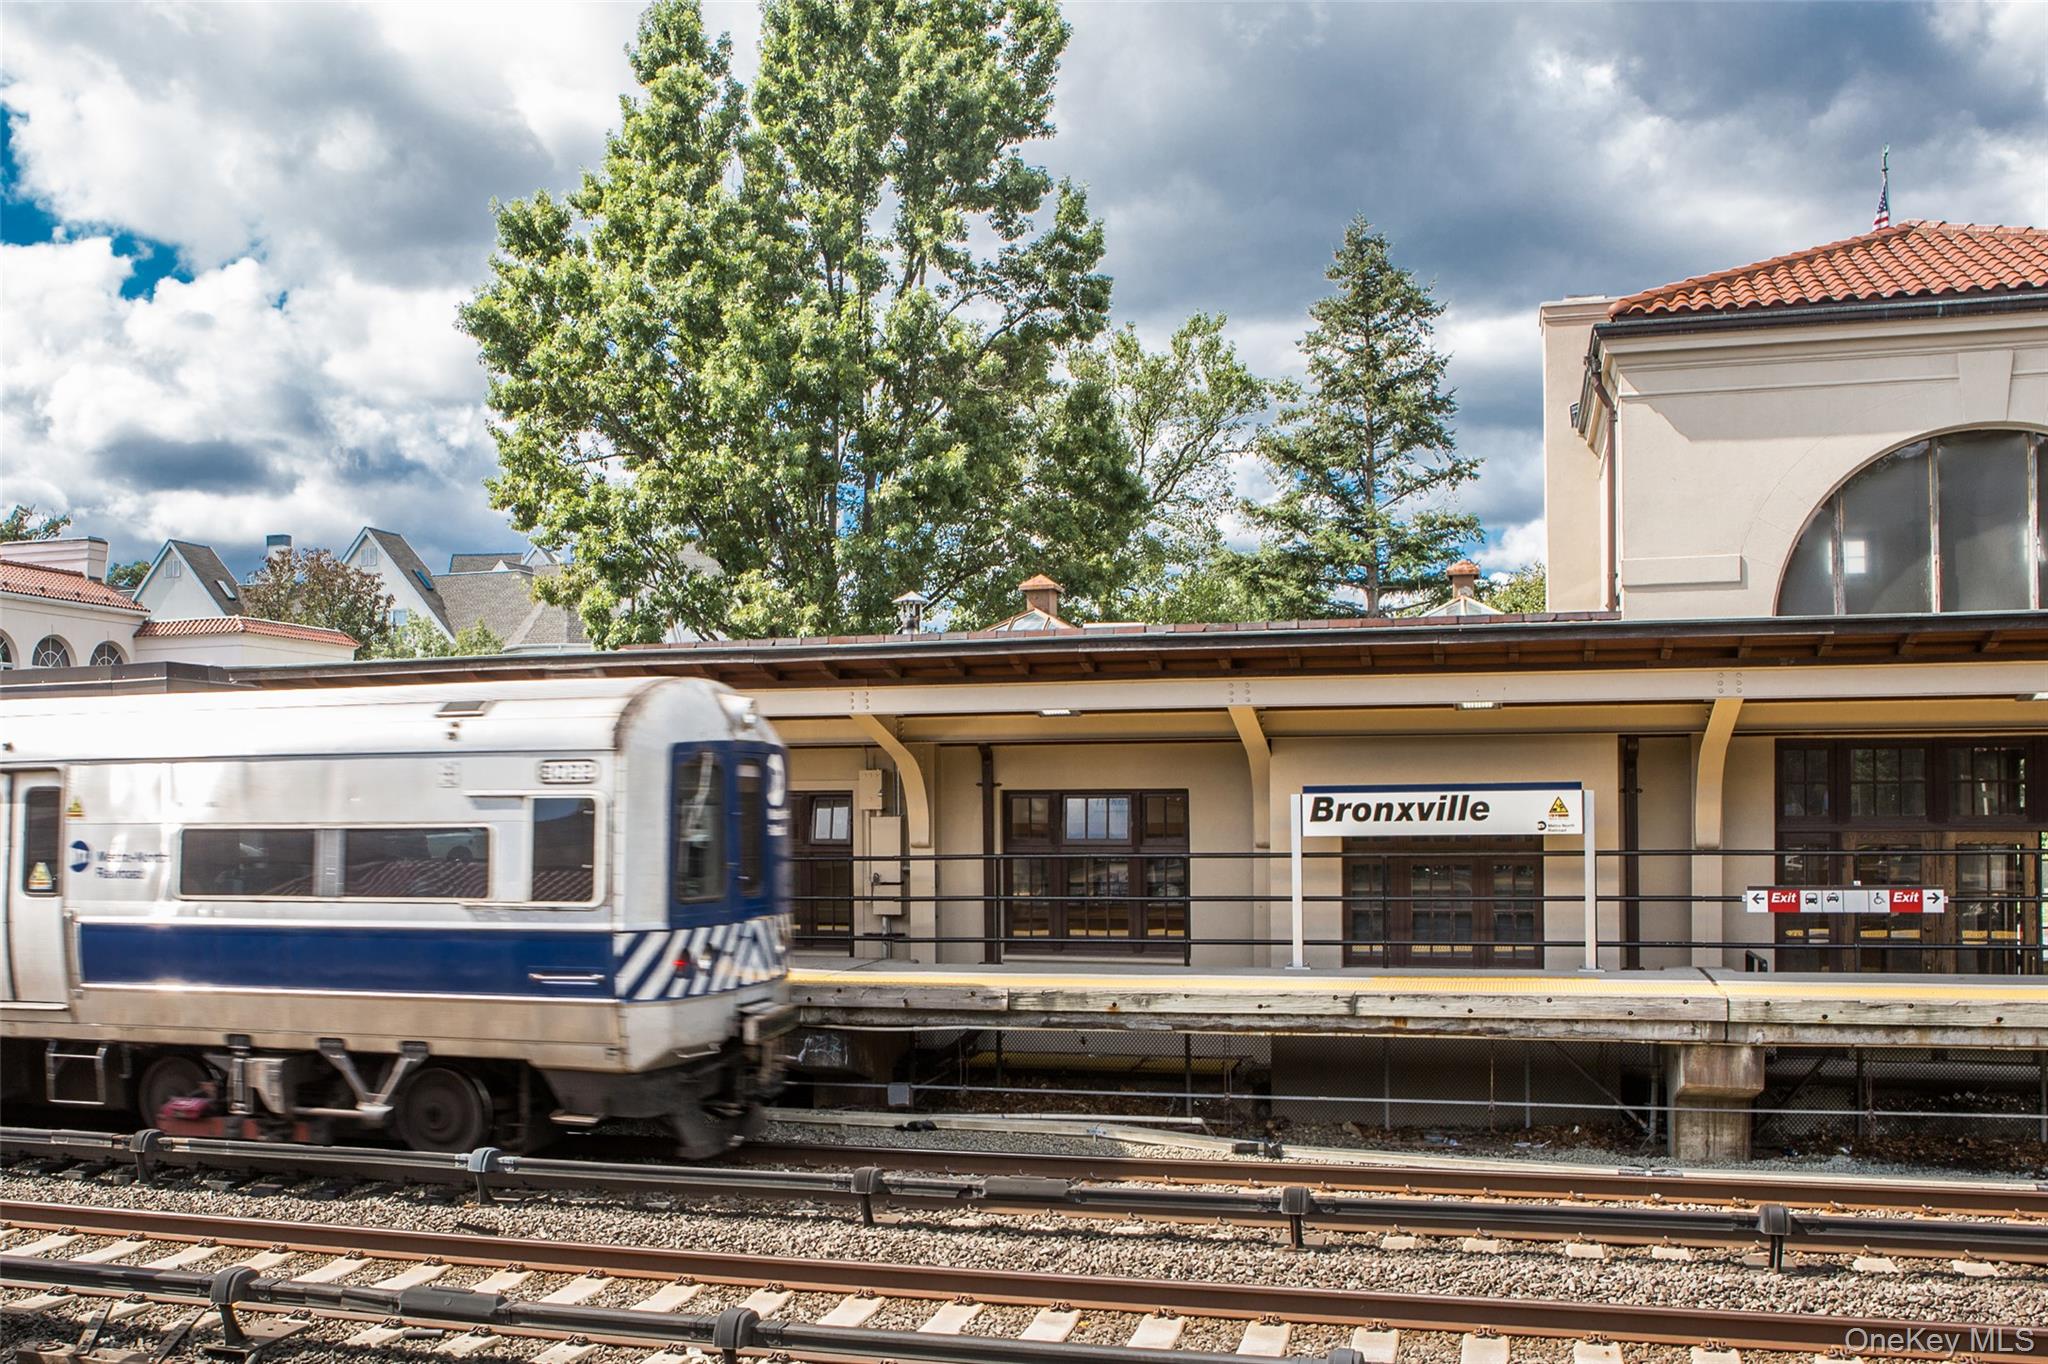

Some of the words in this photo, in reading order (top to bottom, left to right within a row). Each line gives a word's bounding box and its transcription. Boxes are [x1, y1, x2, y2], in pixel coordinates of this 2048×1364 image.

[1310, 795, 1490, 822] Bronxville
[1771, 892, 1797, 903] Exit
[1893, 891, 1920, 903] Exit
